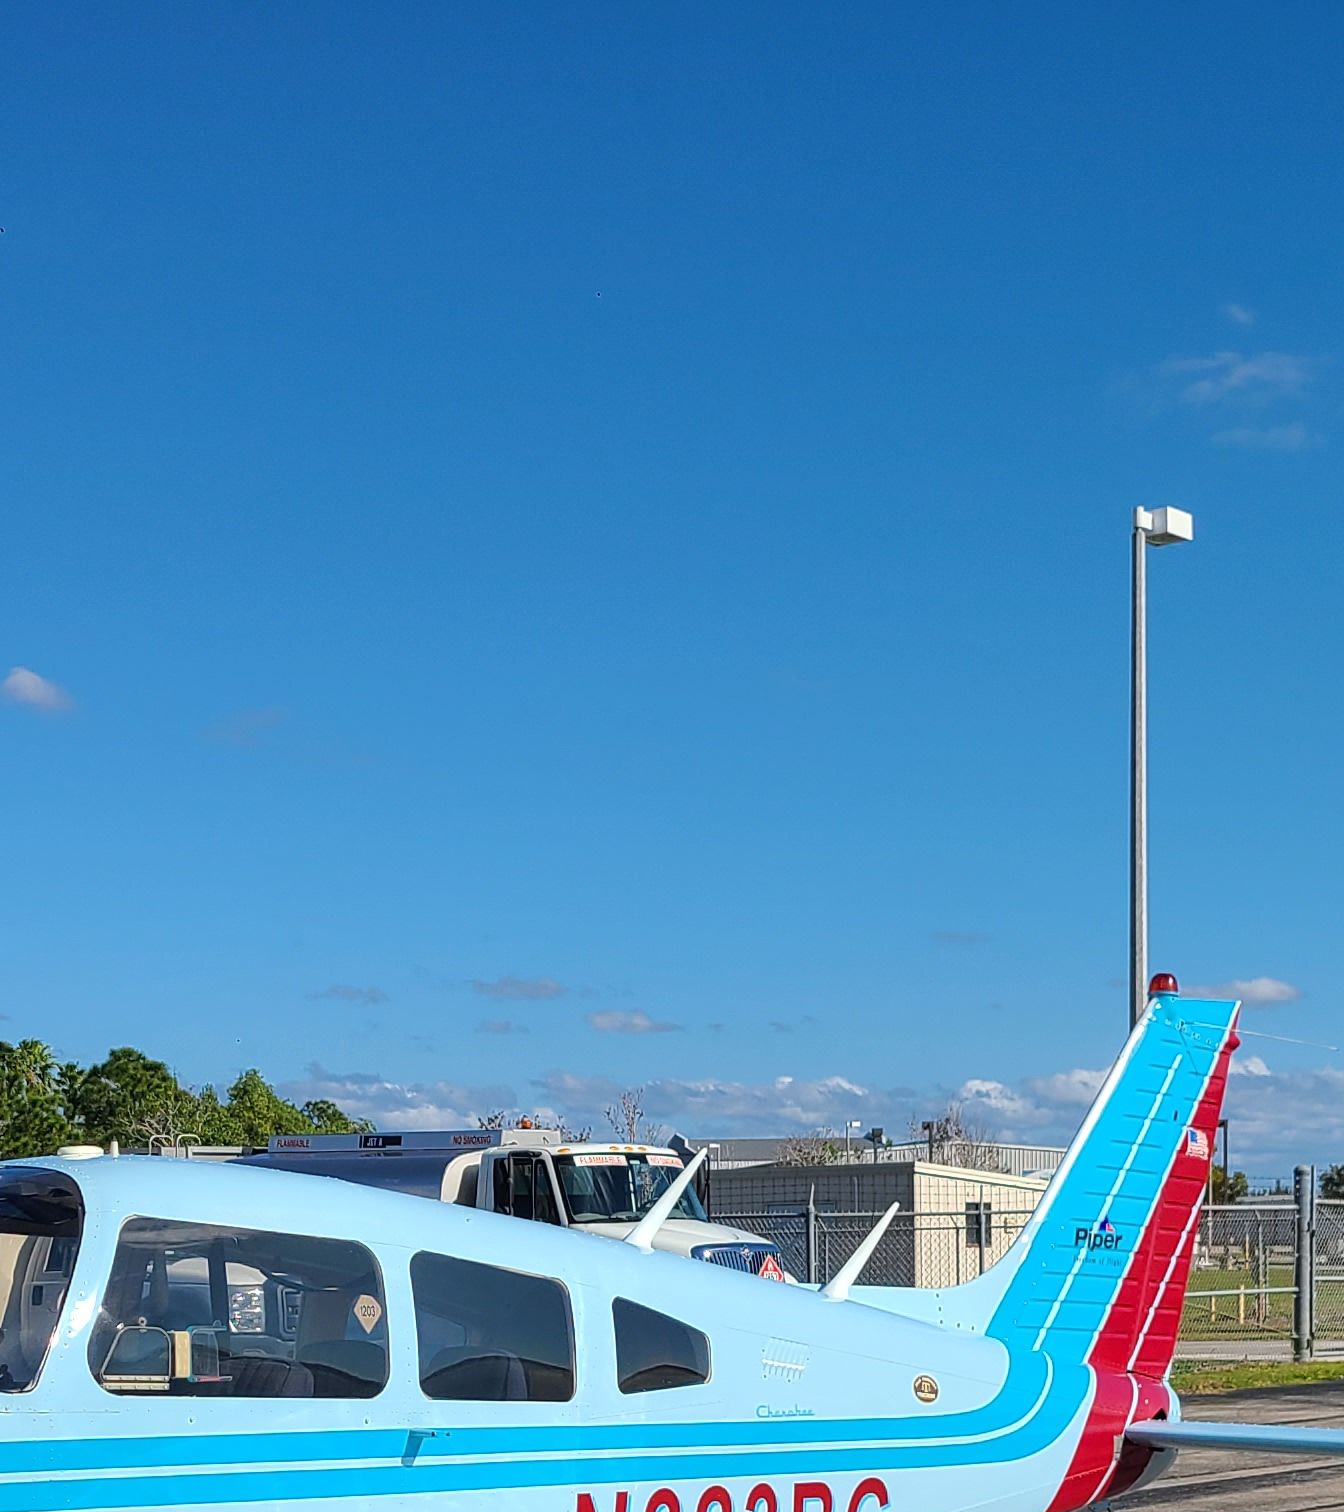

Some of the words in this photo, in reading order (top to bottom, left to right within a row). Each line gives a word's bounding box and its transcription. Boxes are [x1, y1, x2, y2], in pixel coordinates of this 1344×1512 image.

[276, 1138, 310, 1148] FLAMMABLE
[366, 1137, 377, 1147] JET
[452, 1136, 462, 1145] NO
[463, 1135, 492, 1145] SMOKING
[579, 1156, 621, 1164] FLAMMABLE
[1074, 1228, 1123, 1252] Piper
[360, 1305, 376, 1318] 1203
[756, 1404, 815, 1418] Cherokee
